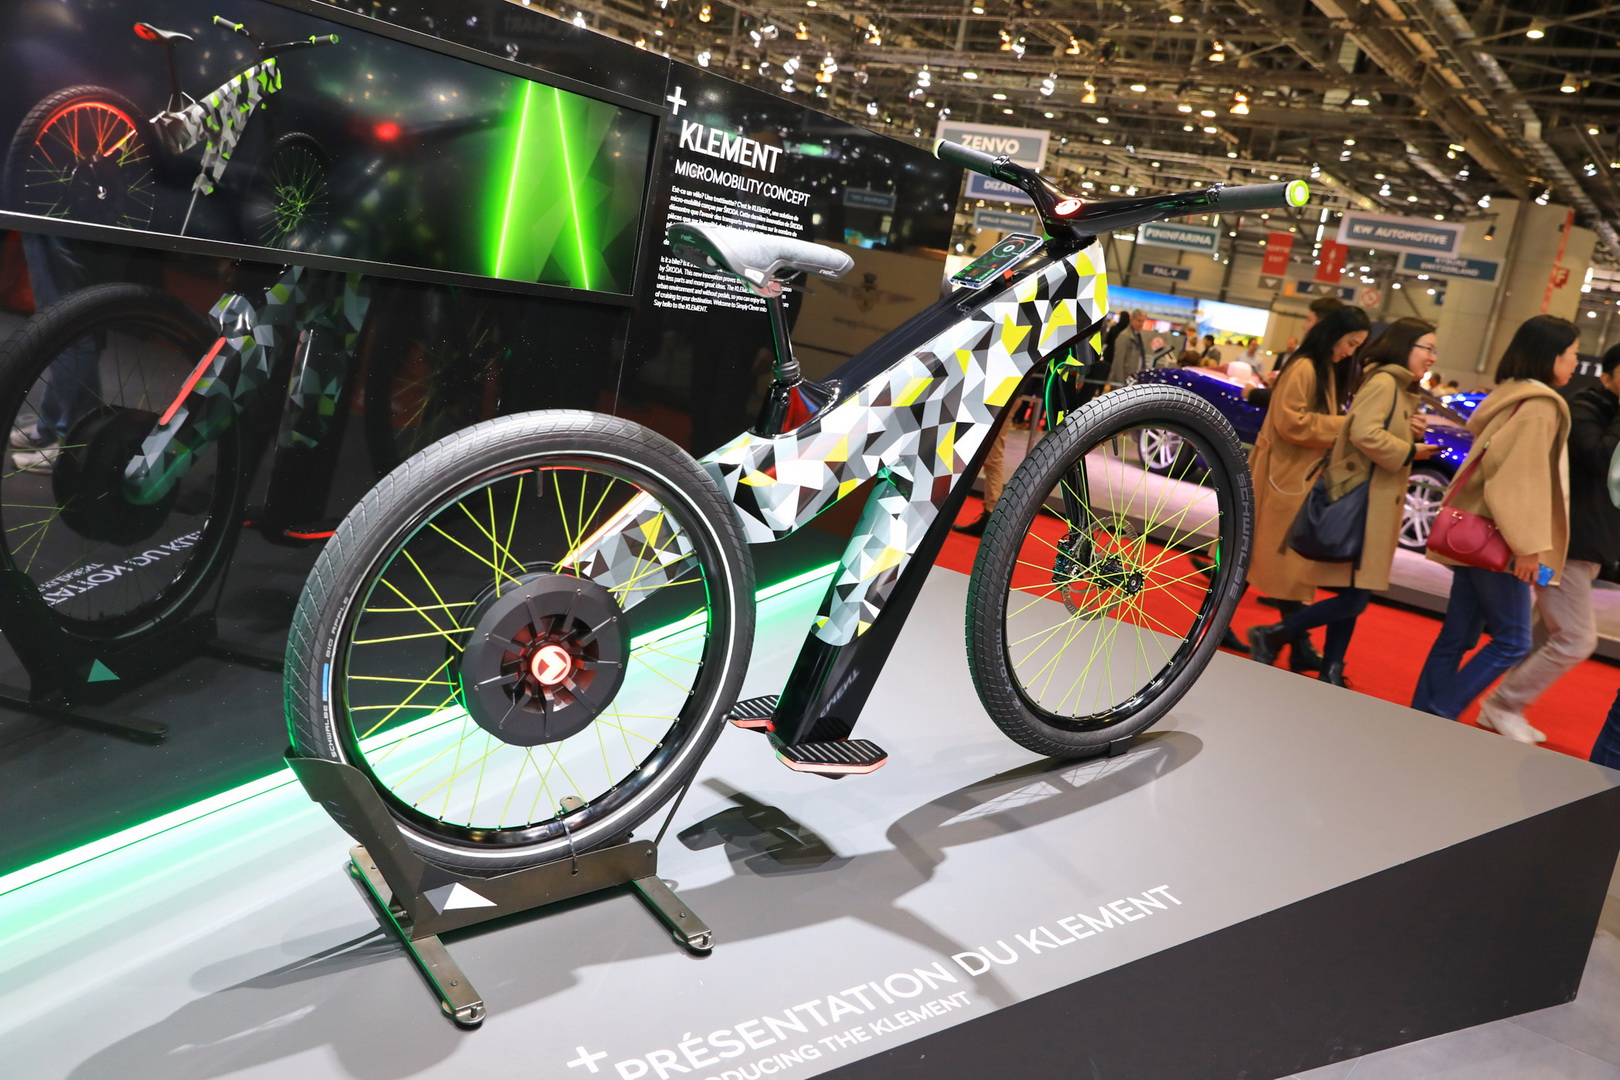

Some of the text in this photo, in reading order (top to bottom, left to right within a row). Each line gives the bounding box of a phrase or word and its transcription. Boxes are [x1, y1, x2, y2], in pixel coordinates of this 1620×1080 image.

[680, 120, 783, 174] KLEMENT
[961, 134, 1020, 155] ZENVO
[675, 159, 811, 207] MICROMOBILITY CONCEPT
[1146, 228, 1212, 246] PININFARINA
[1374, 226, 1448, 245] AUTOMOTIVE
[1152, 266, 1178, 276] PAL-V
[1229, 473, 1250, 600] SCHWALBE
[322, 704, 337, 759] SCHWALBE
[331, 596, 349, 635] APPLE
[614, 884, 1183, 1080] PRÉSENTATION DU KLEMENT
[705, 991, 974, 1080] DUCING THE KLEMENT
